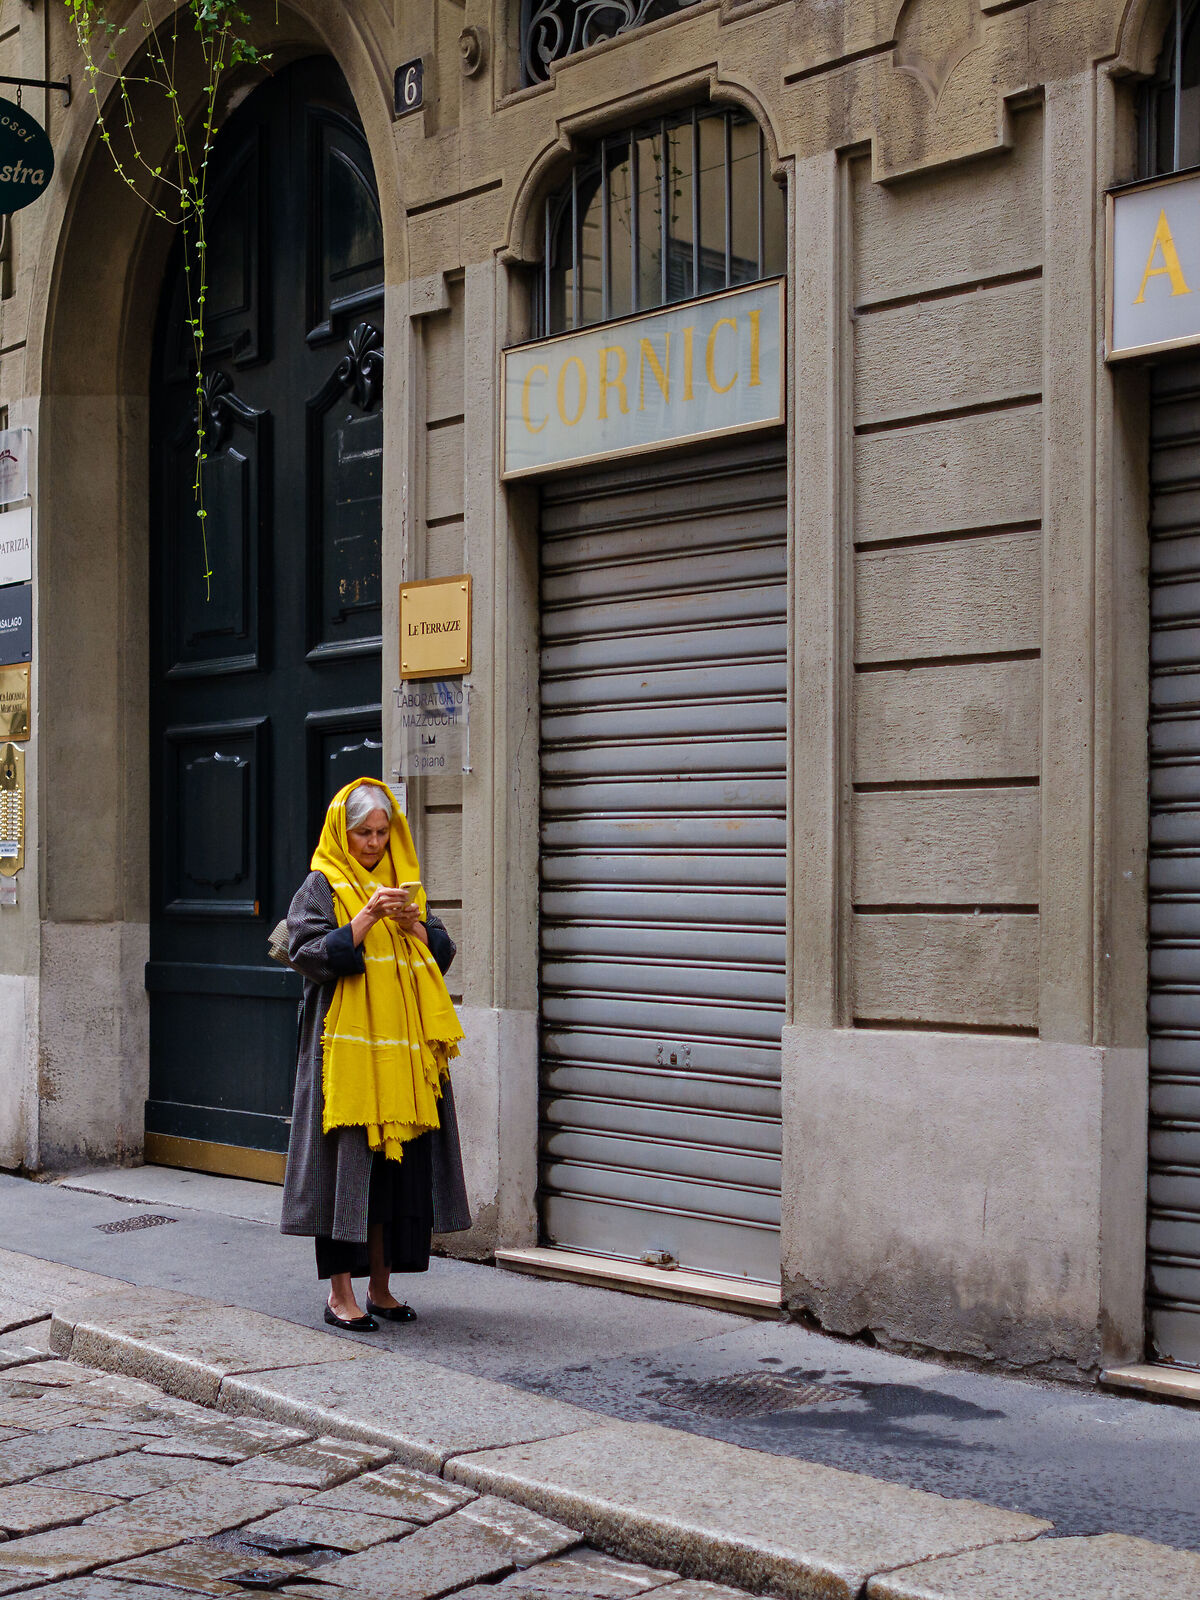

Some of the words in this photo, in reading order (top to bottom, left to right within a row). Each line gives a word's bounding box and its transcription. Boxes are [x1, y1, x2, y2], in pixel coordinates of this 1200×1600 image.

[404, 66, 417, 105] 6
[1132, 208, 1197, 305] A
[521, 309, 763, 434] CORNICI
[397, 690, 464, 708] LABORATORIO
[402, 713, 458, 728] MAZZUCCHI
[422, 755, 445, 772] piano
